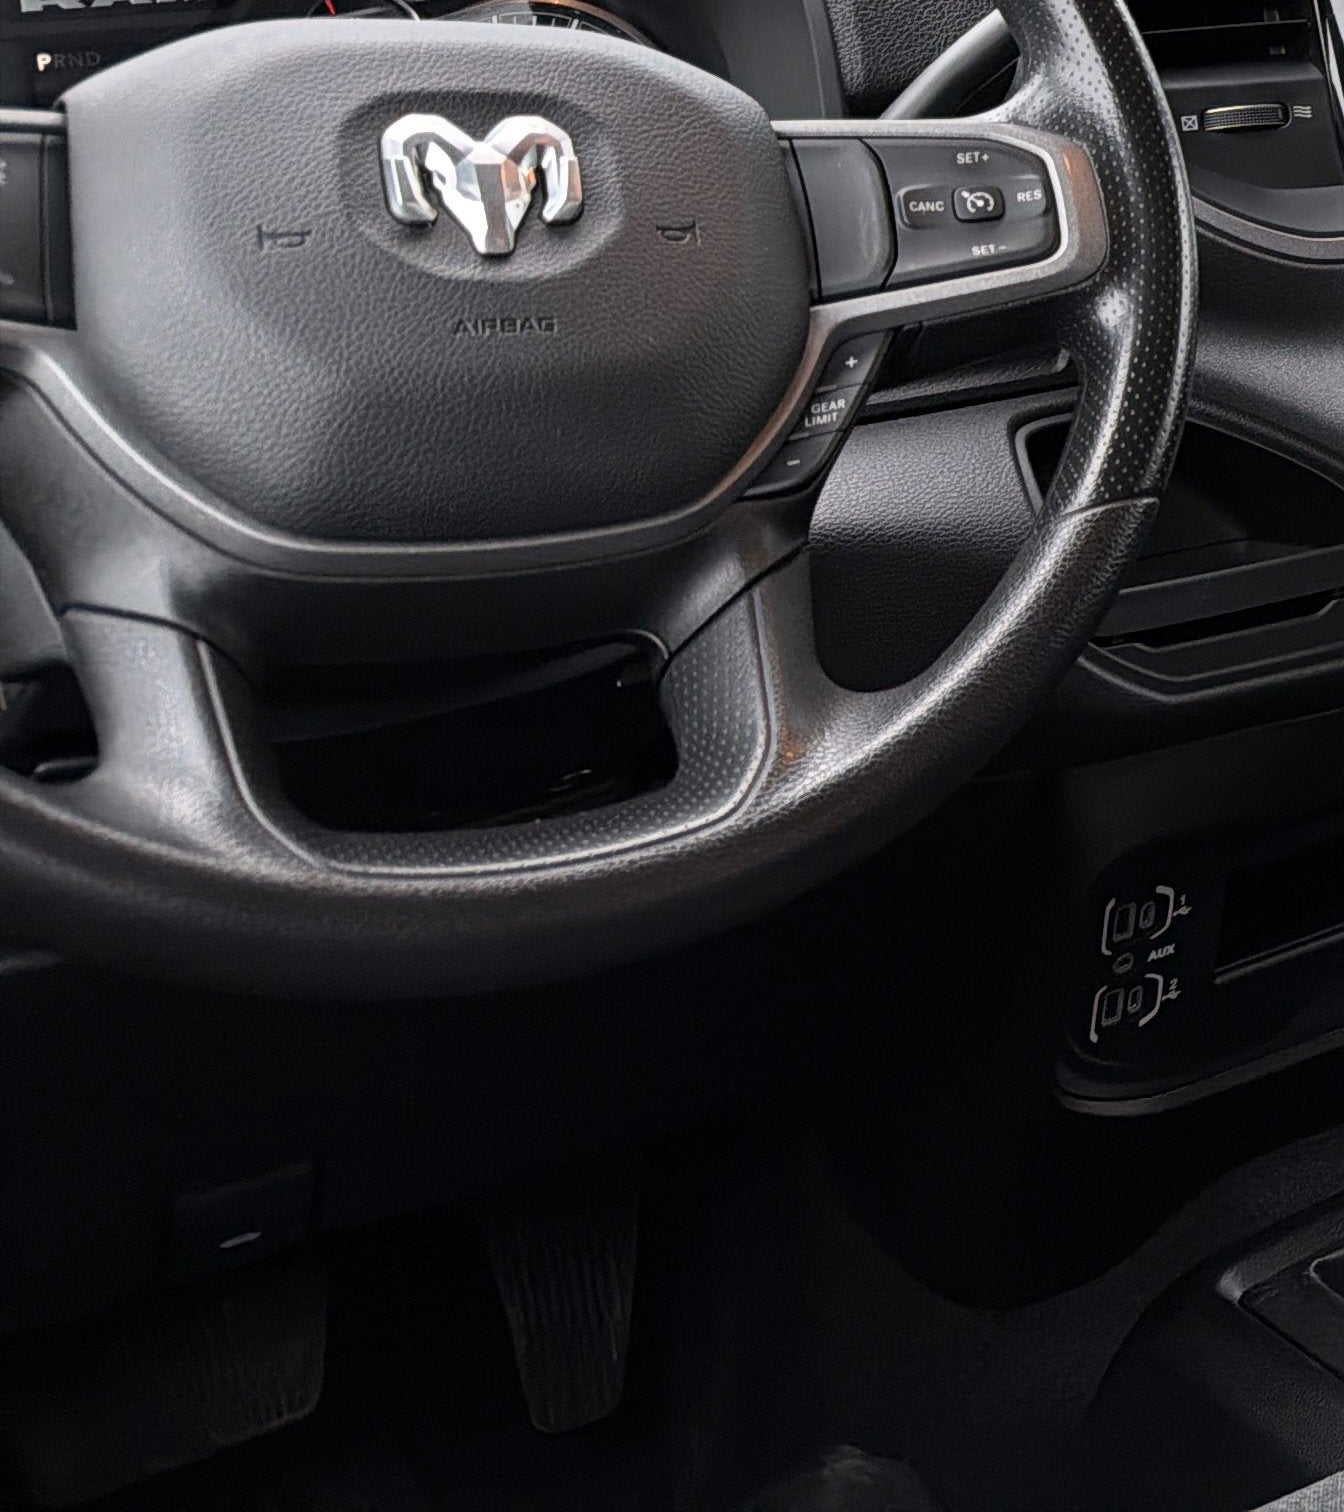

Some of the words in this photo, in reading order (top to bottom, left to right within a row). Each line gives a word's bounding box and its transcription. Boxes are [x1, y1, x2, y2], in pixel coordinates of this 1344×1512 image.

[1016, 189, 1042, 202] RES
[909, 201, 945, 212] CANC
[453, 317, 557, 336] AIRBAG
[811, 398, 846, 414] GEAR
[805, 412, 839, 427] LIMIT
[1147, 943, 1176, 962] AUX
[1169, 978, 1178, 990] 2
